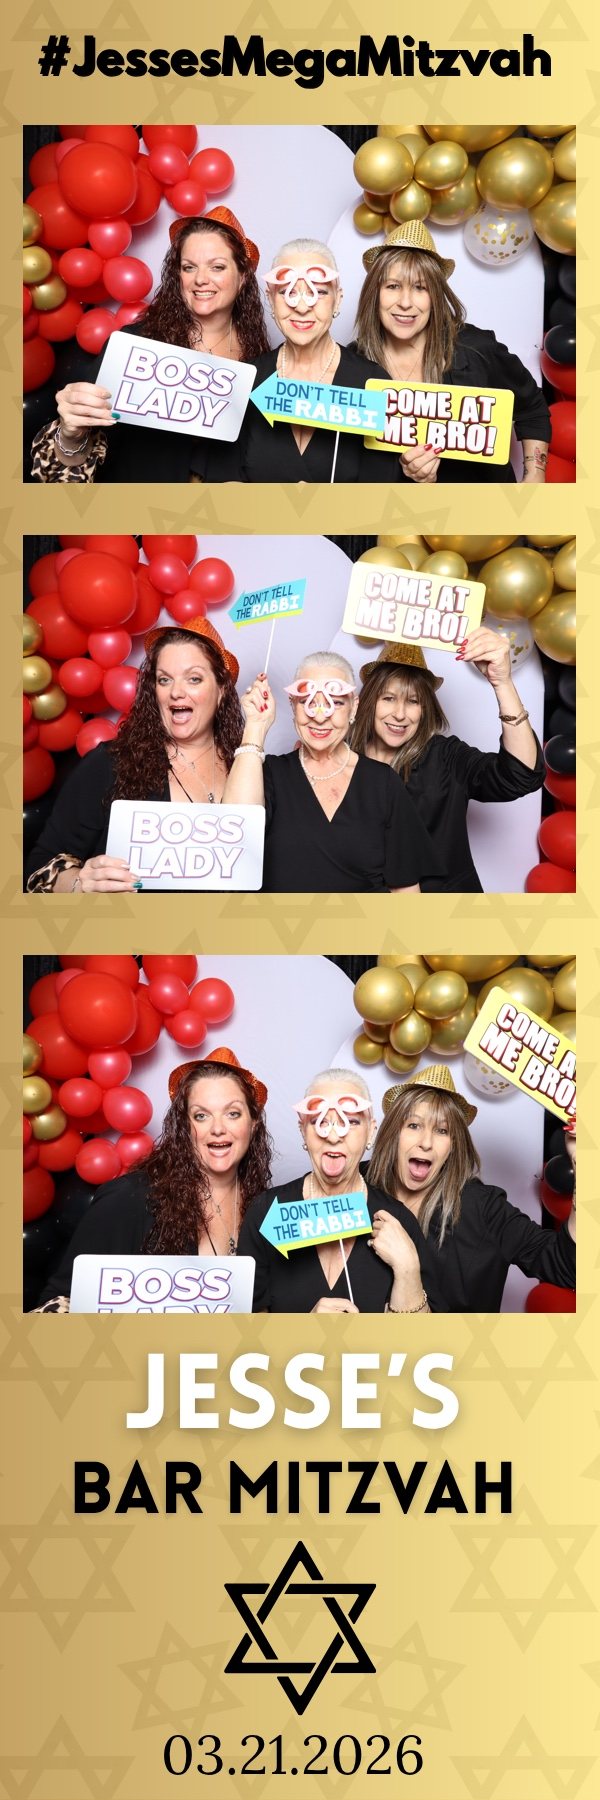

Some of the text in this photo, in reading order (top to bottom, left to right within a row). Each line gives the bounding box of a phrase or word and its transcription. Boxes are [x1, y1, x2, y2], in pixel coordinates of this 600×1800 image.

[123, 346, 237, 397] BOSS
[113, 380, 230, 428] LADY
[264, 396, 379, 429] THE RABBI
[276, 381, 367, 408] DON'T TELL
[382, 388, 496, 424] COME AT
[375, 415, 498, 457] ME BRO!
[236, 595, 300, 620] THE RABBI
[243, 585, 293, 606] DON'T TELL
[364, 571, 471, 613] COME AT
[355, 598, 469, 646] ME BRO!
[130, 811, 245, 844] BOSS
[128, 846, 244, 879] LADY
[478, 1022, 524, 1073] ME
[495, 1003, 576, 1080] COME A
[273, 1210, 366, 1241] THE RABBI
[280, 1198, 354, 1222] DON'T TELL
[98, 1267, 233, 1305] BOSS
